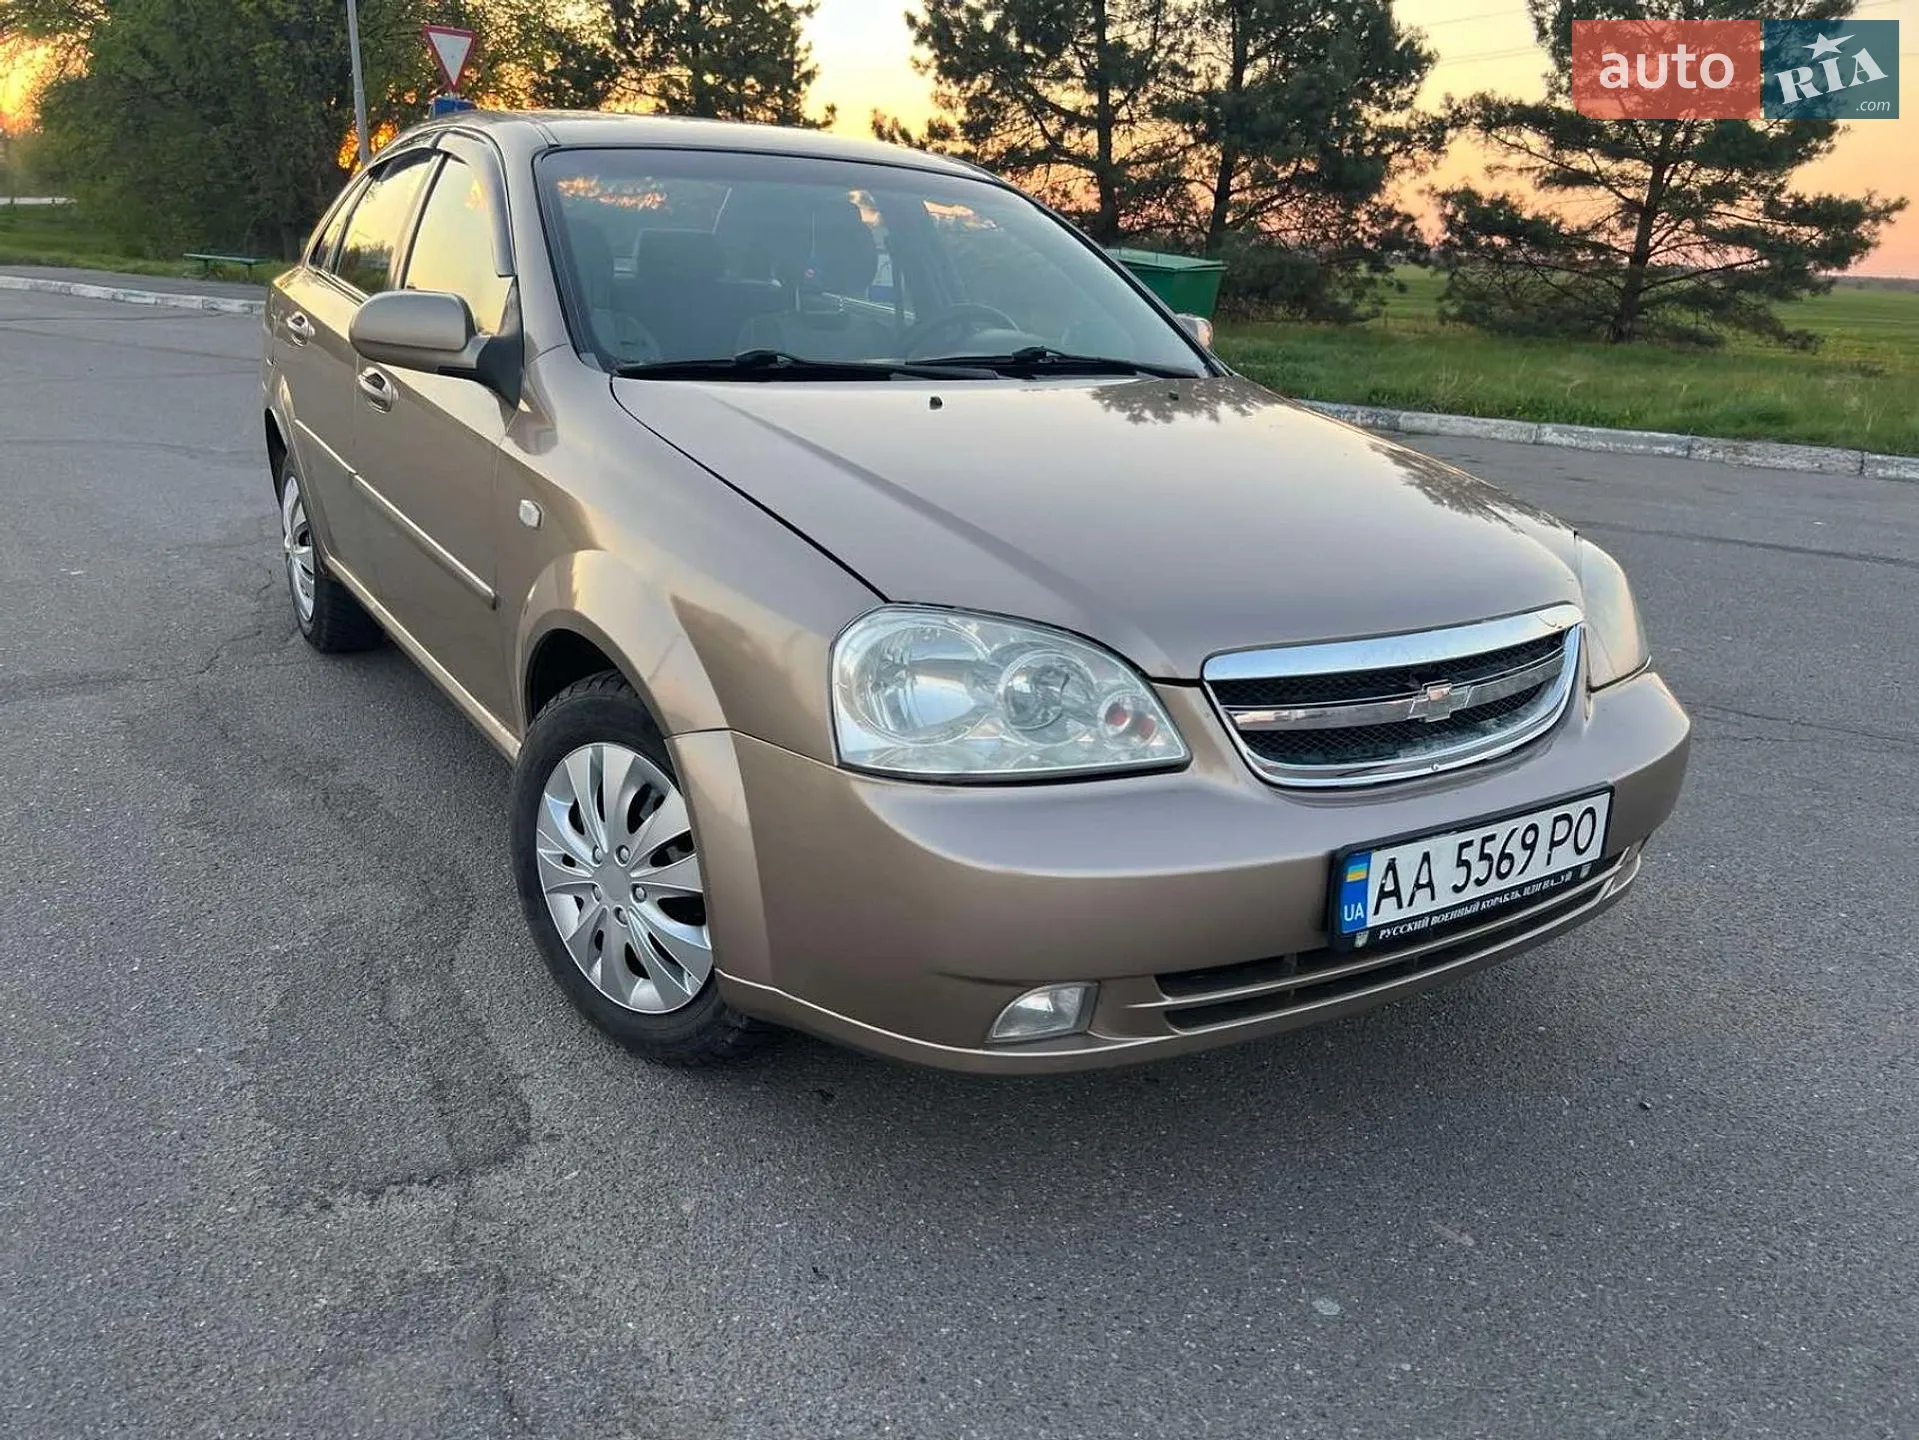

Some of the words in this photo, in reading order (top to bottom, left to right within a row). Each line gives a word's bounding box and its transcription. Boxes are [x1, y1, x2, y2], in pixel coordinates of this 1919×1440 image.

[1373, 851, 1436, 916] AA
[1451, 822, 1540, 894] 5569
[1546, 806, 1598, 867] PO
[1343, 903, 1365, 922] UA
[1379, 916, 1430, 940] РУССКИЙ
